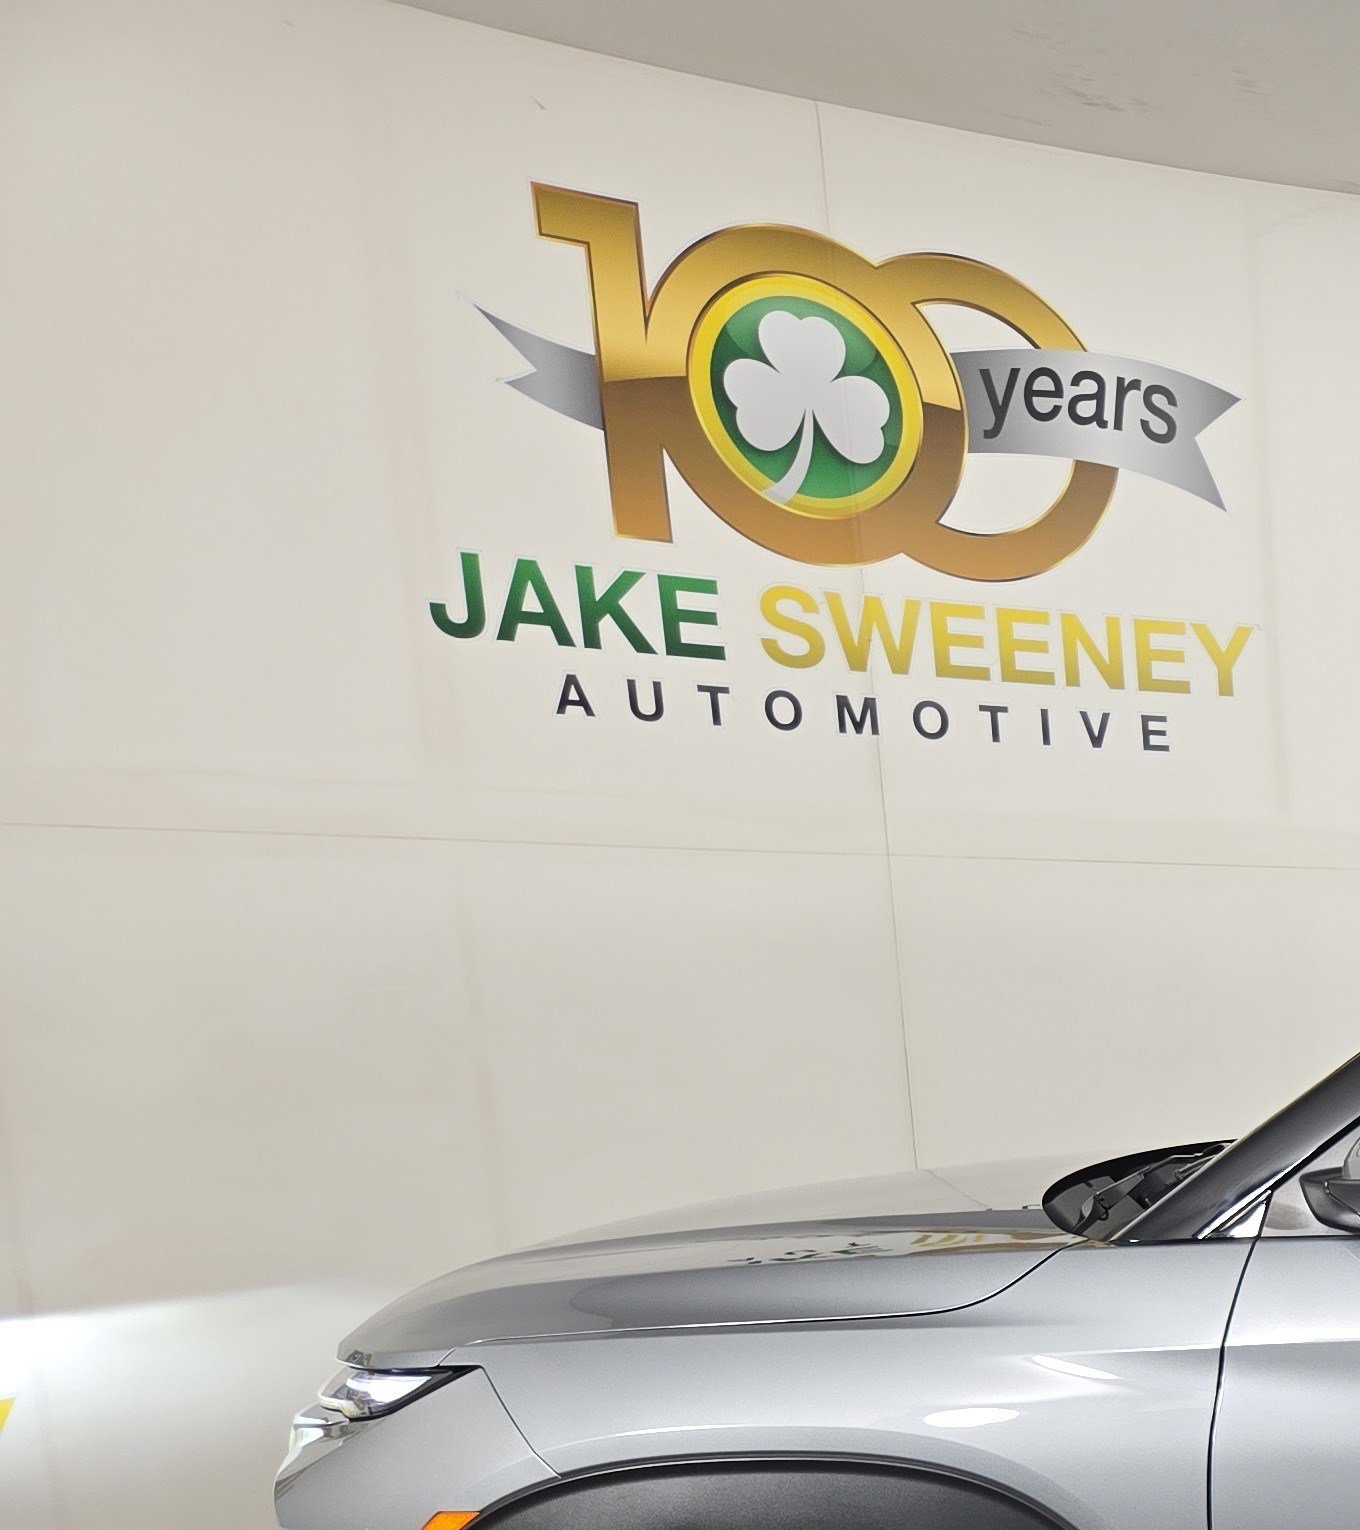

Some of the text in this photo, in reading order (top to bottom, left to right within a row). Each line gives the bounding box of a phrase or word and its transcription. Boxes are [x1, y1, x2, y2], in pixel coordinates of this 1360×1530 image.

[531, 181, 1119, 582] 100
[979, 363, 1178, 444] years
[428, 551, 1256, 697] JAKE SWEENEY
[555, 672, 1171, 752] AUTOMOTIVE
